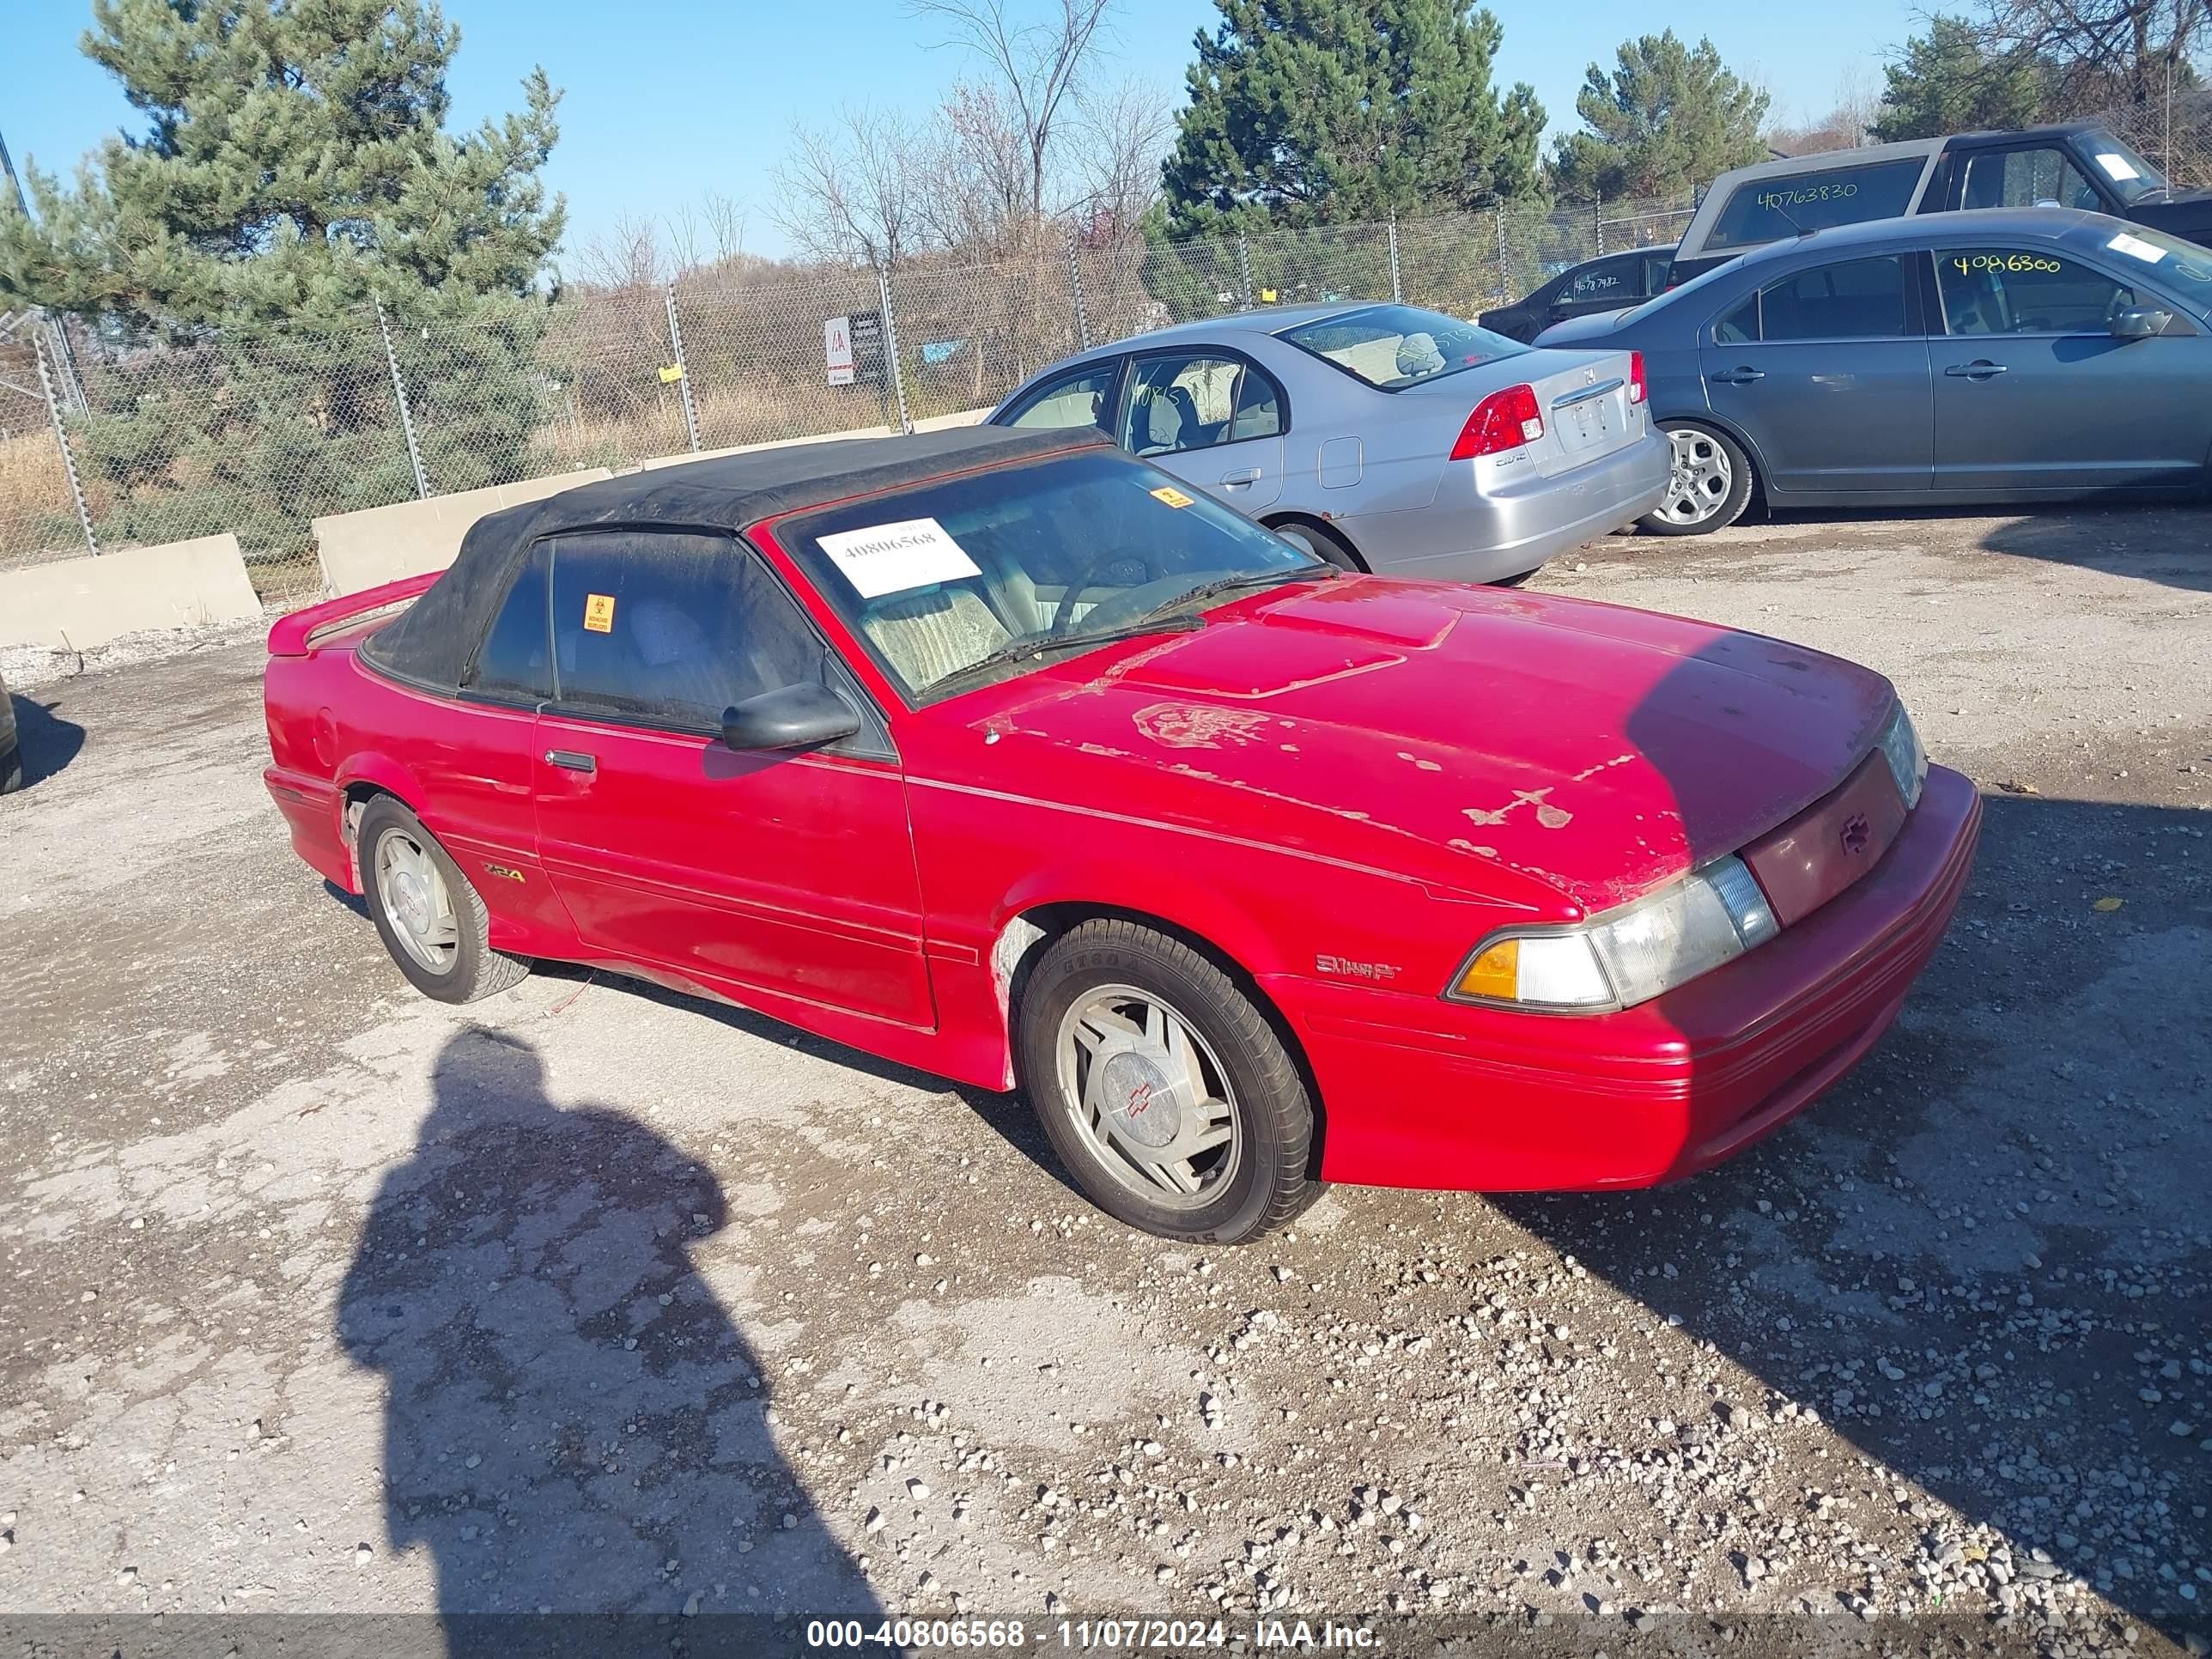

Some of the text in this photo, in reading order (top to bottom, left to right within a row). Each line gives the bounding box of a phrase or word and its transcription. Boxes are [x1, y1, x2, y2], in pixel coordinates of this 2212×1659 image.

[1758, 184, 1857, 211] 40763830
[1575, 276, 1621, 295] 40787982
[845, 532, 938, 558] 40806568
